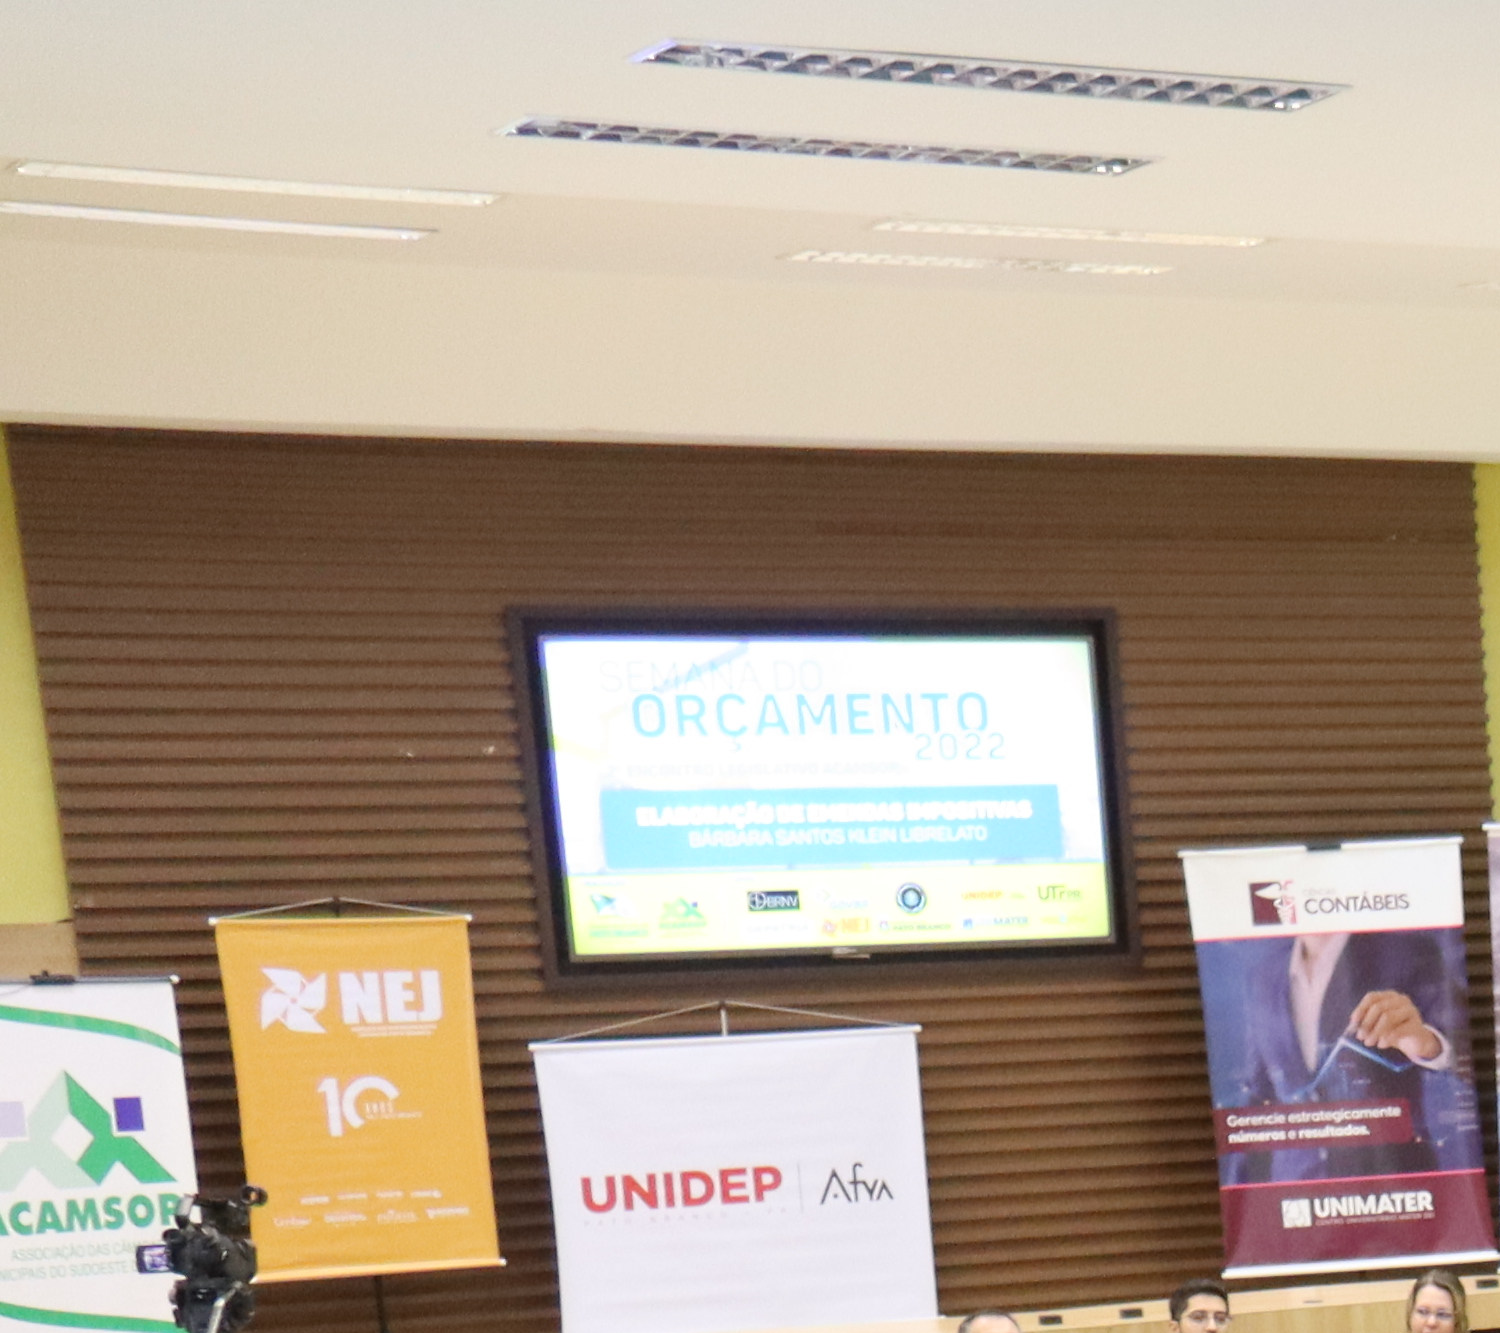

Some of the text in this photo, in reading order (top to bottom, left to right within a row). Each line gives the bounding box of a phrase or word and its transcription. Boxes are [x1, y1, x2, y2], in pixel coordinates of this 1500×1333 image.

[600, 659, 823, 693] SEMANA DO
[631, 691, 990, 752] ORÇAMENTO
[915, 732, 1008, 760] 2022
[635, 799, 1033, 829] ELABORAÇÃO DE EMENDAS IMPOSITIVAS
[775, 826, 846, 846] SANTOS
[848, 825, 898, 845] KLEIN
[899, 824, 988, 843] LIBRELATO
[1304, 892, 1410, 914] CONTÁBEIS
[338, 969, 443, 1025] NEJ
[1226, 1113, 1286, 1128] Gerencie
[1227, 1128, 1287, 1144] números
[580, 1165, 783, 1214] UNIDEP
[1312, 1190, 1434, 1219] UNIMATER
[87, 1243, 110, 1257] DAS
[49, 1266, 67, 1279] DO
[69, 1260, 127, 1277] SUDOESTE
